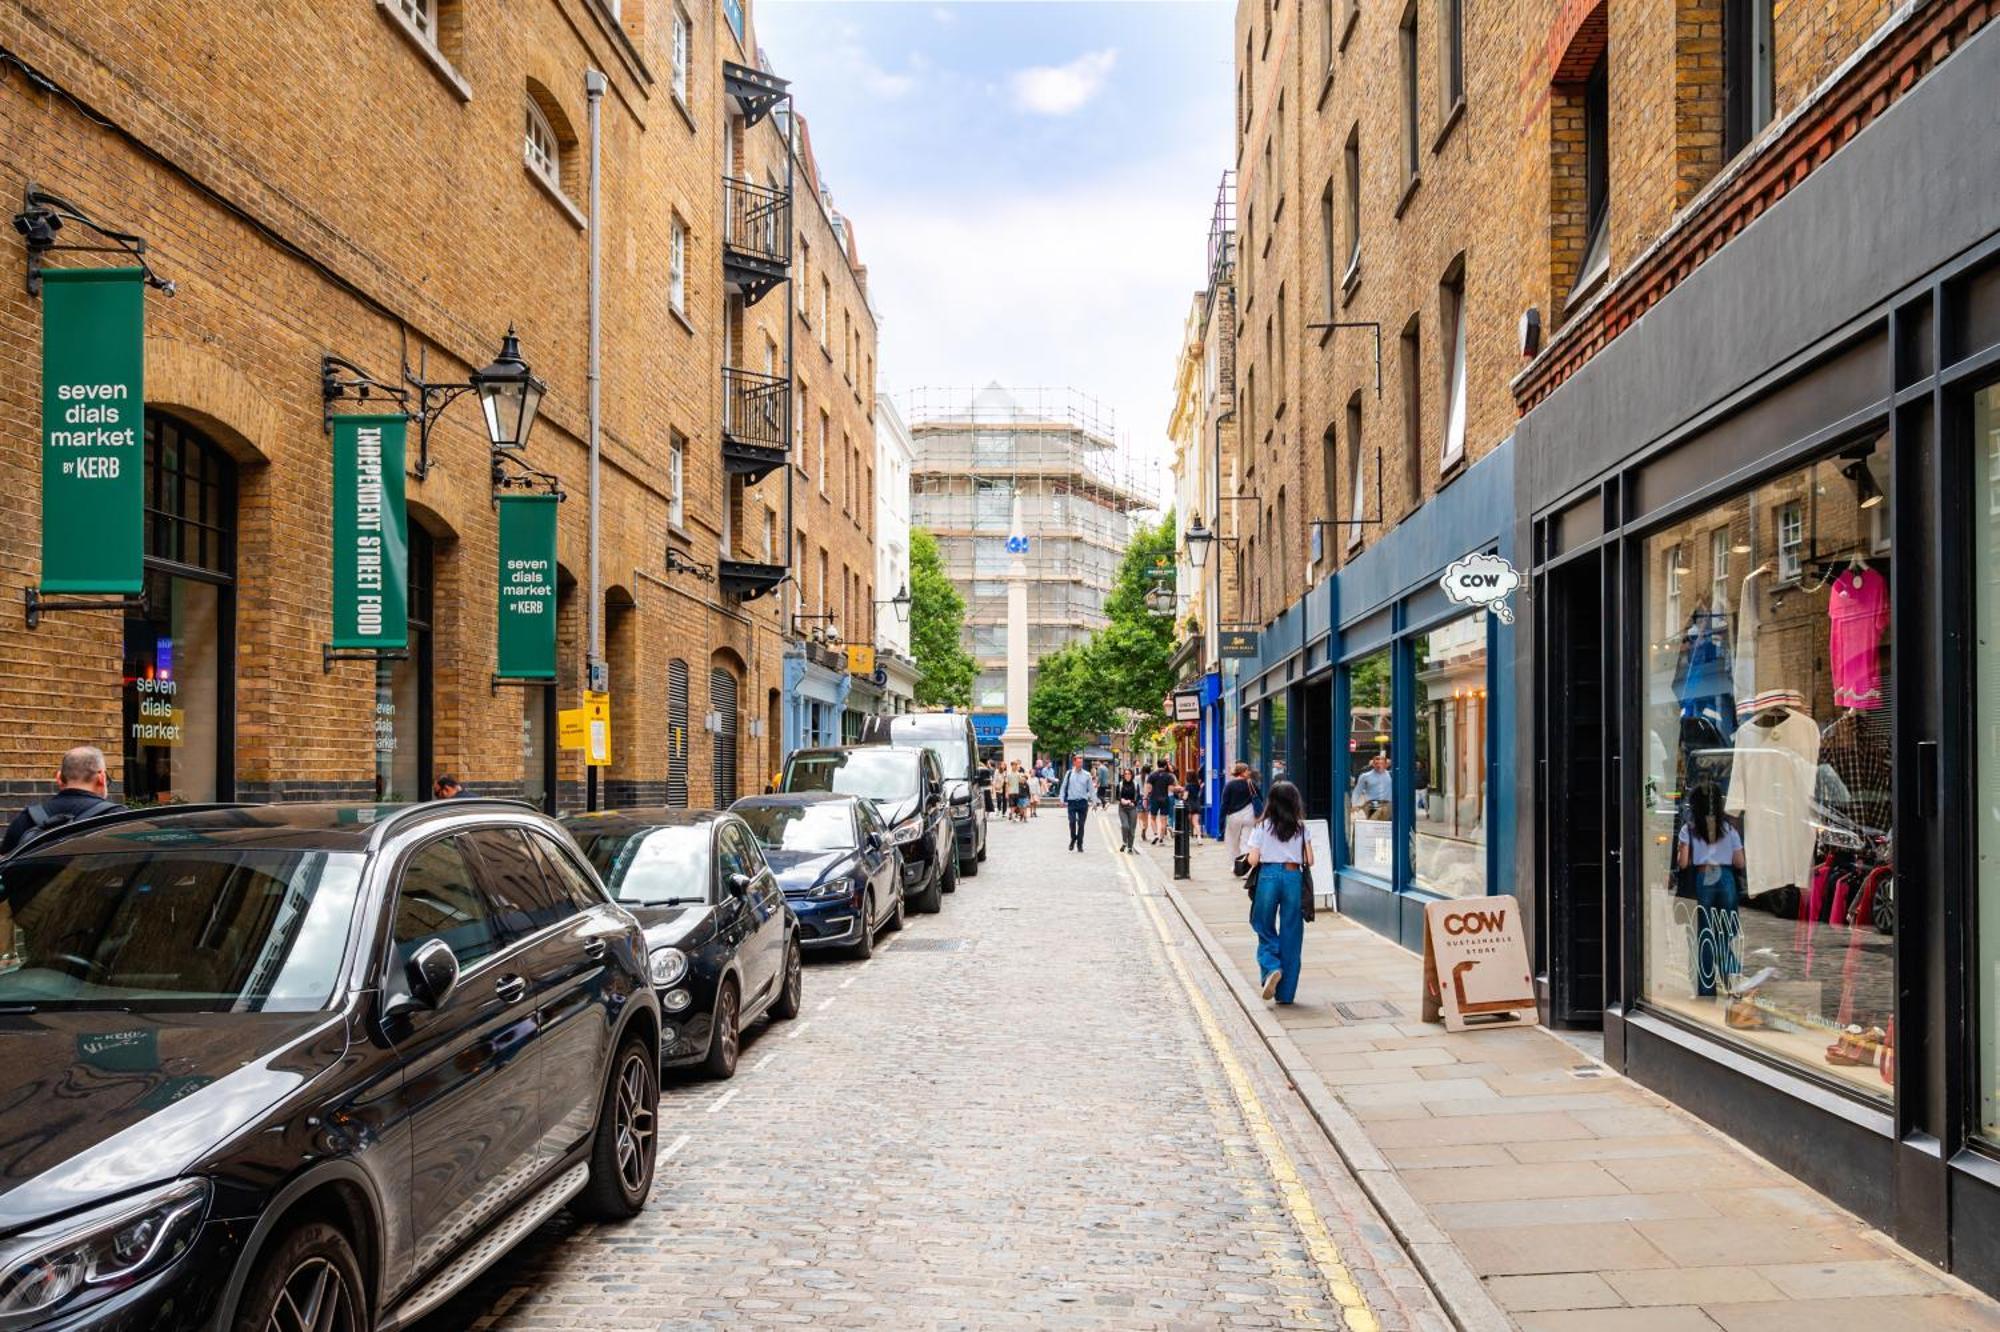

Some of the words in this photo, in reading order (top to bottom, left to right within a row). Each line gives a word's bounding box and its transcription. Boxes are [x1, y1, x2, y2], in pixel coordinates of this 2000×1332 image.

[57, 384, 128, 400] seven
[65, 403, 120, 423] dials
[51, 427, 134, 446] market
[63, 462, 75, 474] BY
[77, 456, 120, 478] KERB
[357, 427, 382, 532] INDEPENDENT
[357, 536, 382, 591] STREET
[507, 560, 548, 569] seven
[511, 570, 543, 582] dials
[1460, 574, 1500, 587] COW
[503, 584, 552, 596] market
[357, 595, 382, 636] FOOD
[518, 600, 544, 614] KERB
[136, 677, 177, 695] seven
[140, 697, 172, 717] dials
[376, 703, 396, 716] even
[132, 721, 180, 740] market
[376, 735, 398, 750] arket
[1443, 910, 1506, 936] COW
[1446, 936, 1511, 947] SUSTAINABLE
[1466, 947, 1496, 955] STORE
